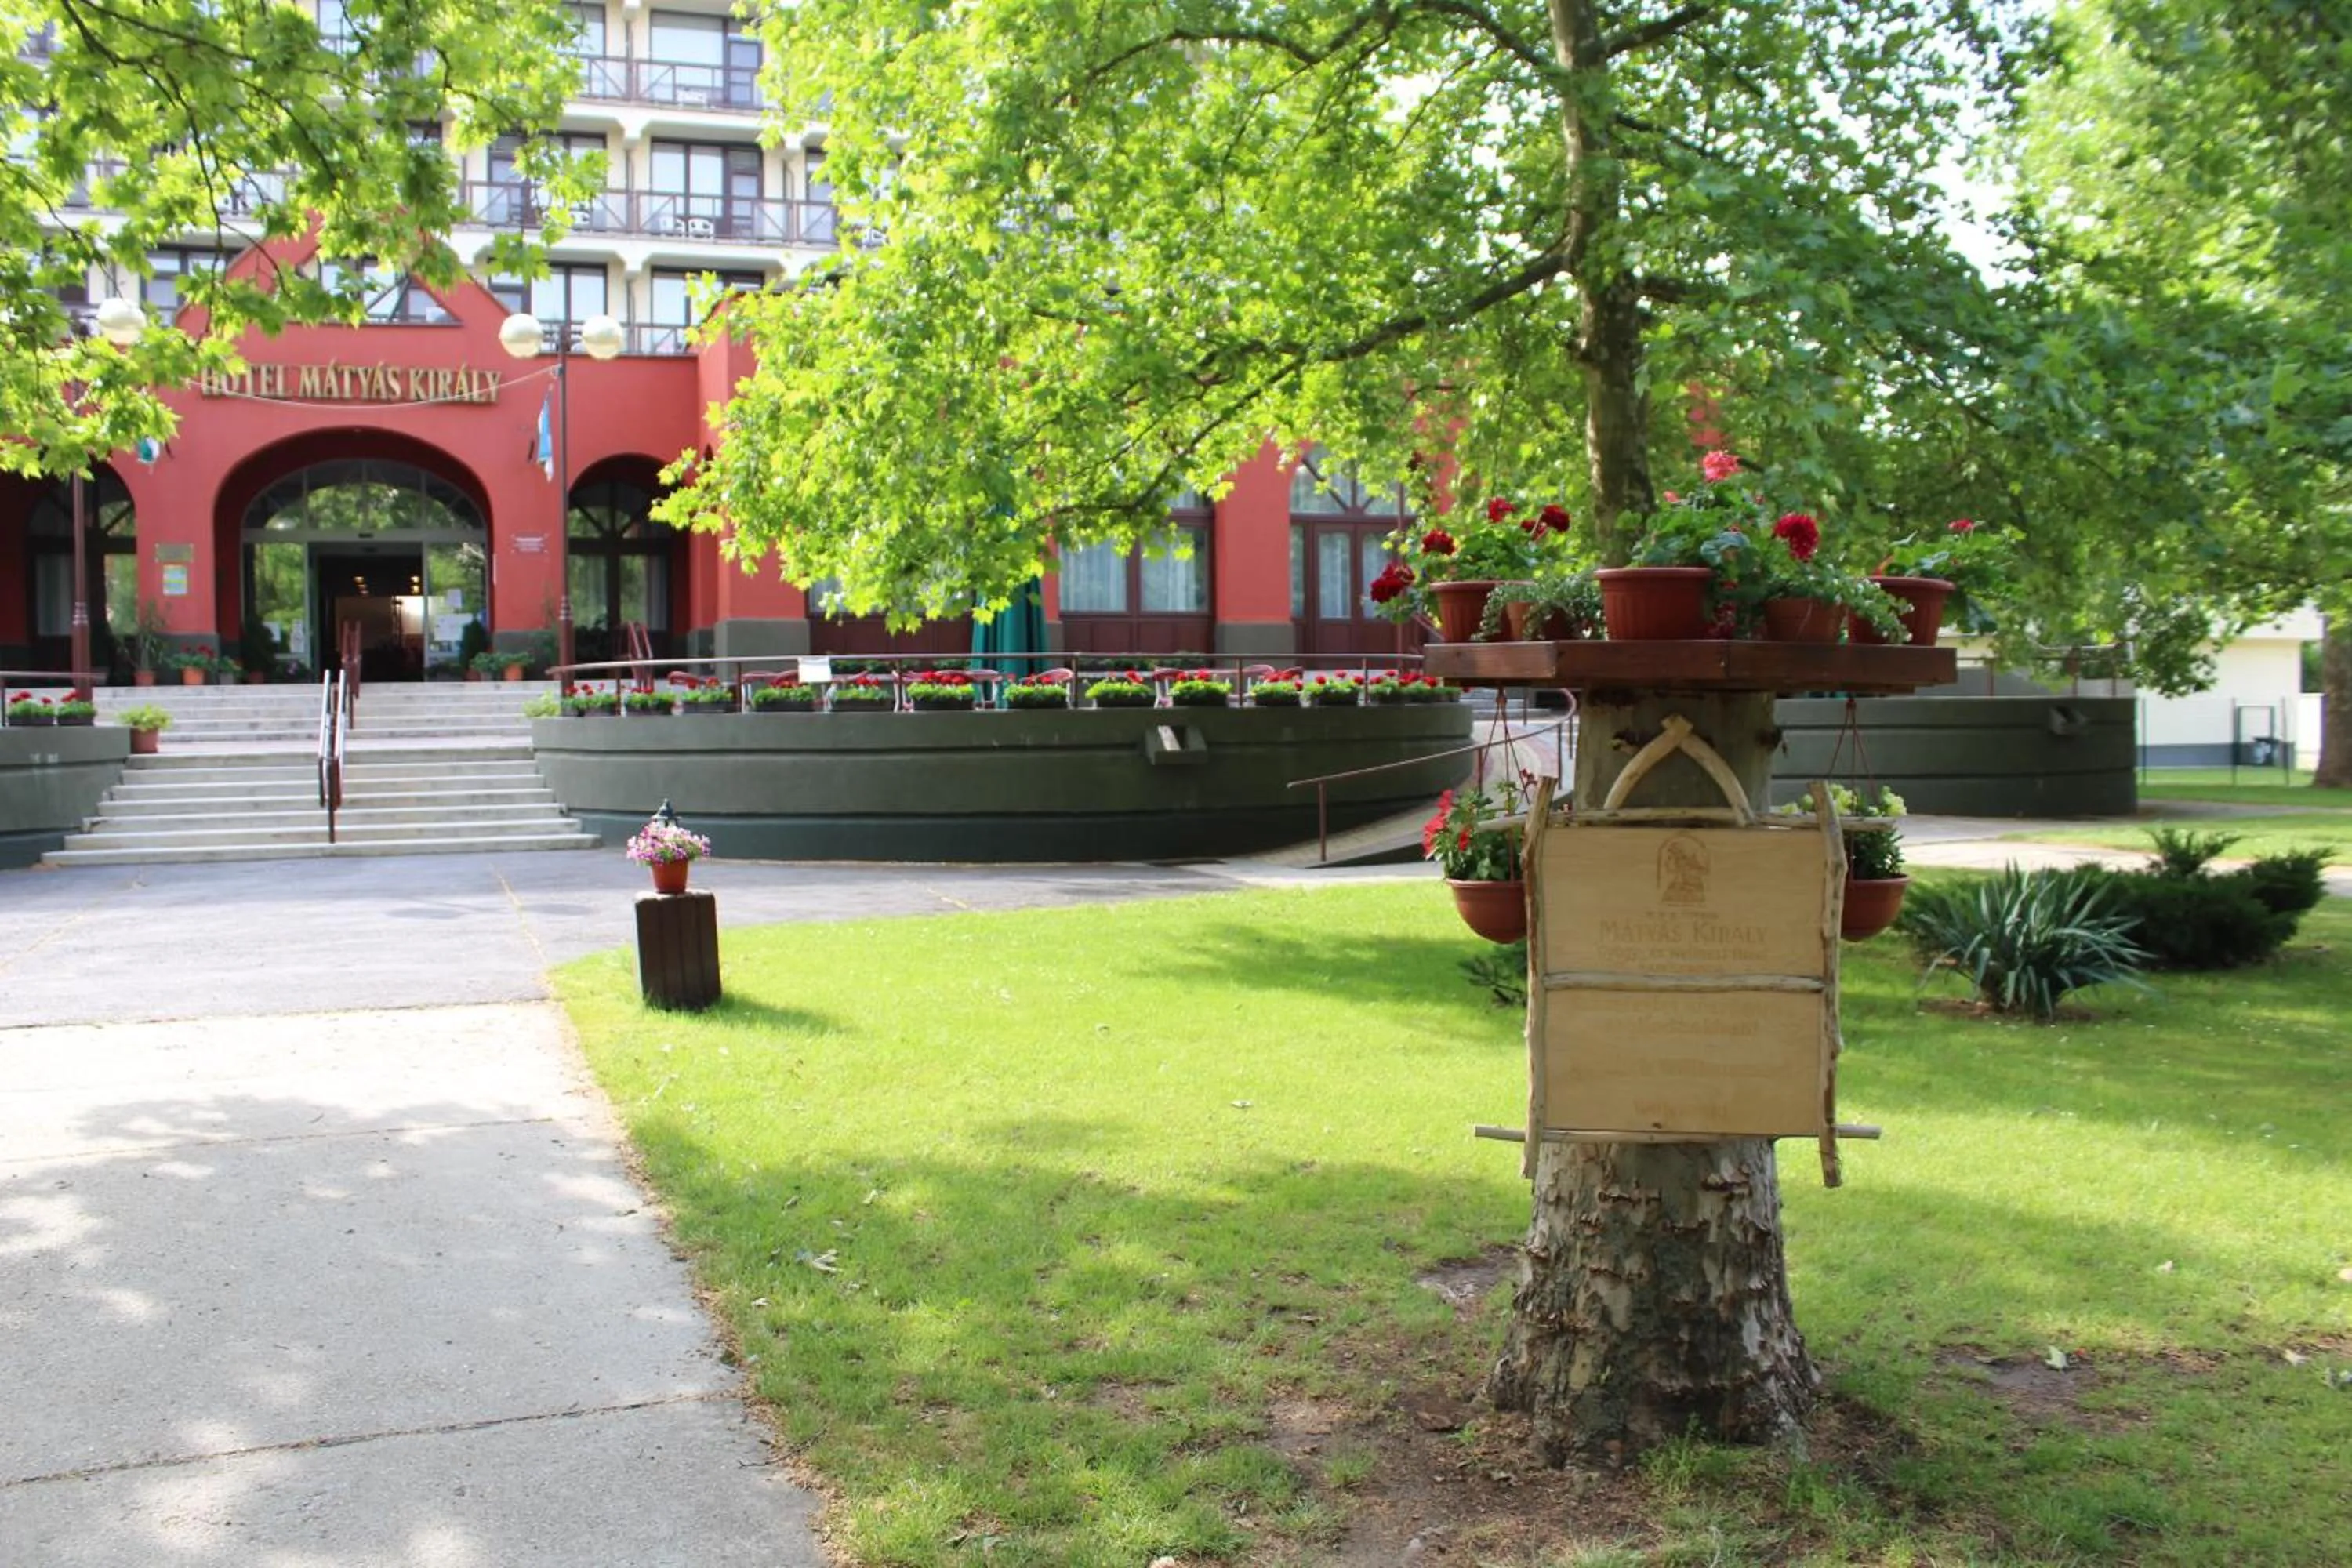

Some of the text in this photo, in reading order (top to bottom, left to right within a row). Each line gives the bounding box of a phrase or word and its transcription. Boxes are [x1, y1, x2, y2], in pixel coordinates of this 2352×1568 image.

[201, 358, 502, 403] HOTEL MÁTYÁS KIRÁLY
